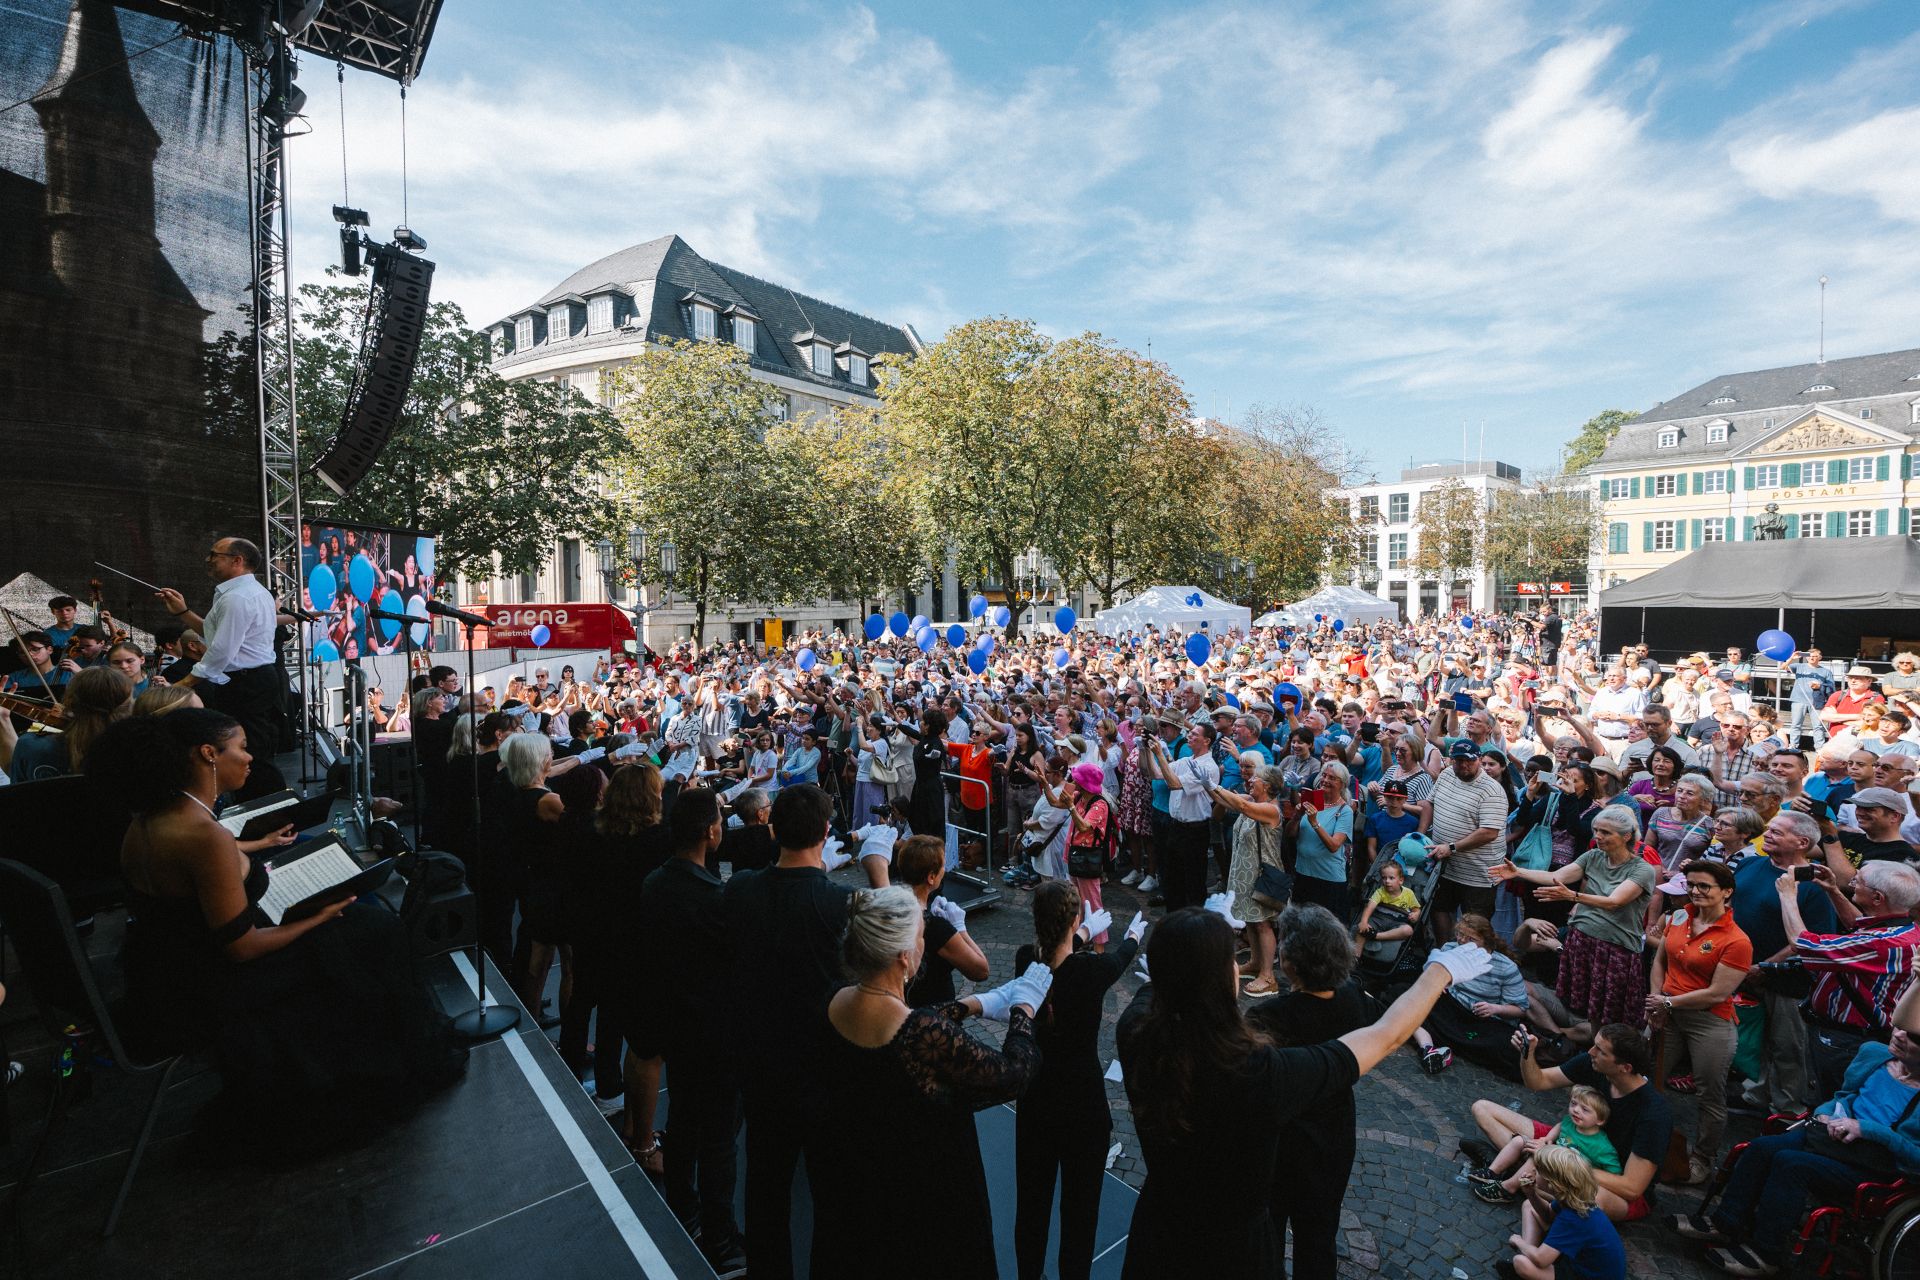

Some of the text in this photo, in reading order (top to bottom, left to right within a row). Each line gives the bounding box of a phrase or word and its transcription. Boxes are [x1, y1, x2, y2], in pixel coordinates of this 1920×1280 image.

[1772, 487, 1856, 499] POSTAMT
[497, 609, 568, 626] arena
[498, 629, 533, 637] mietmöb
